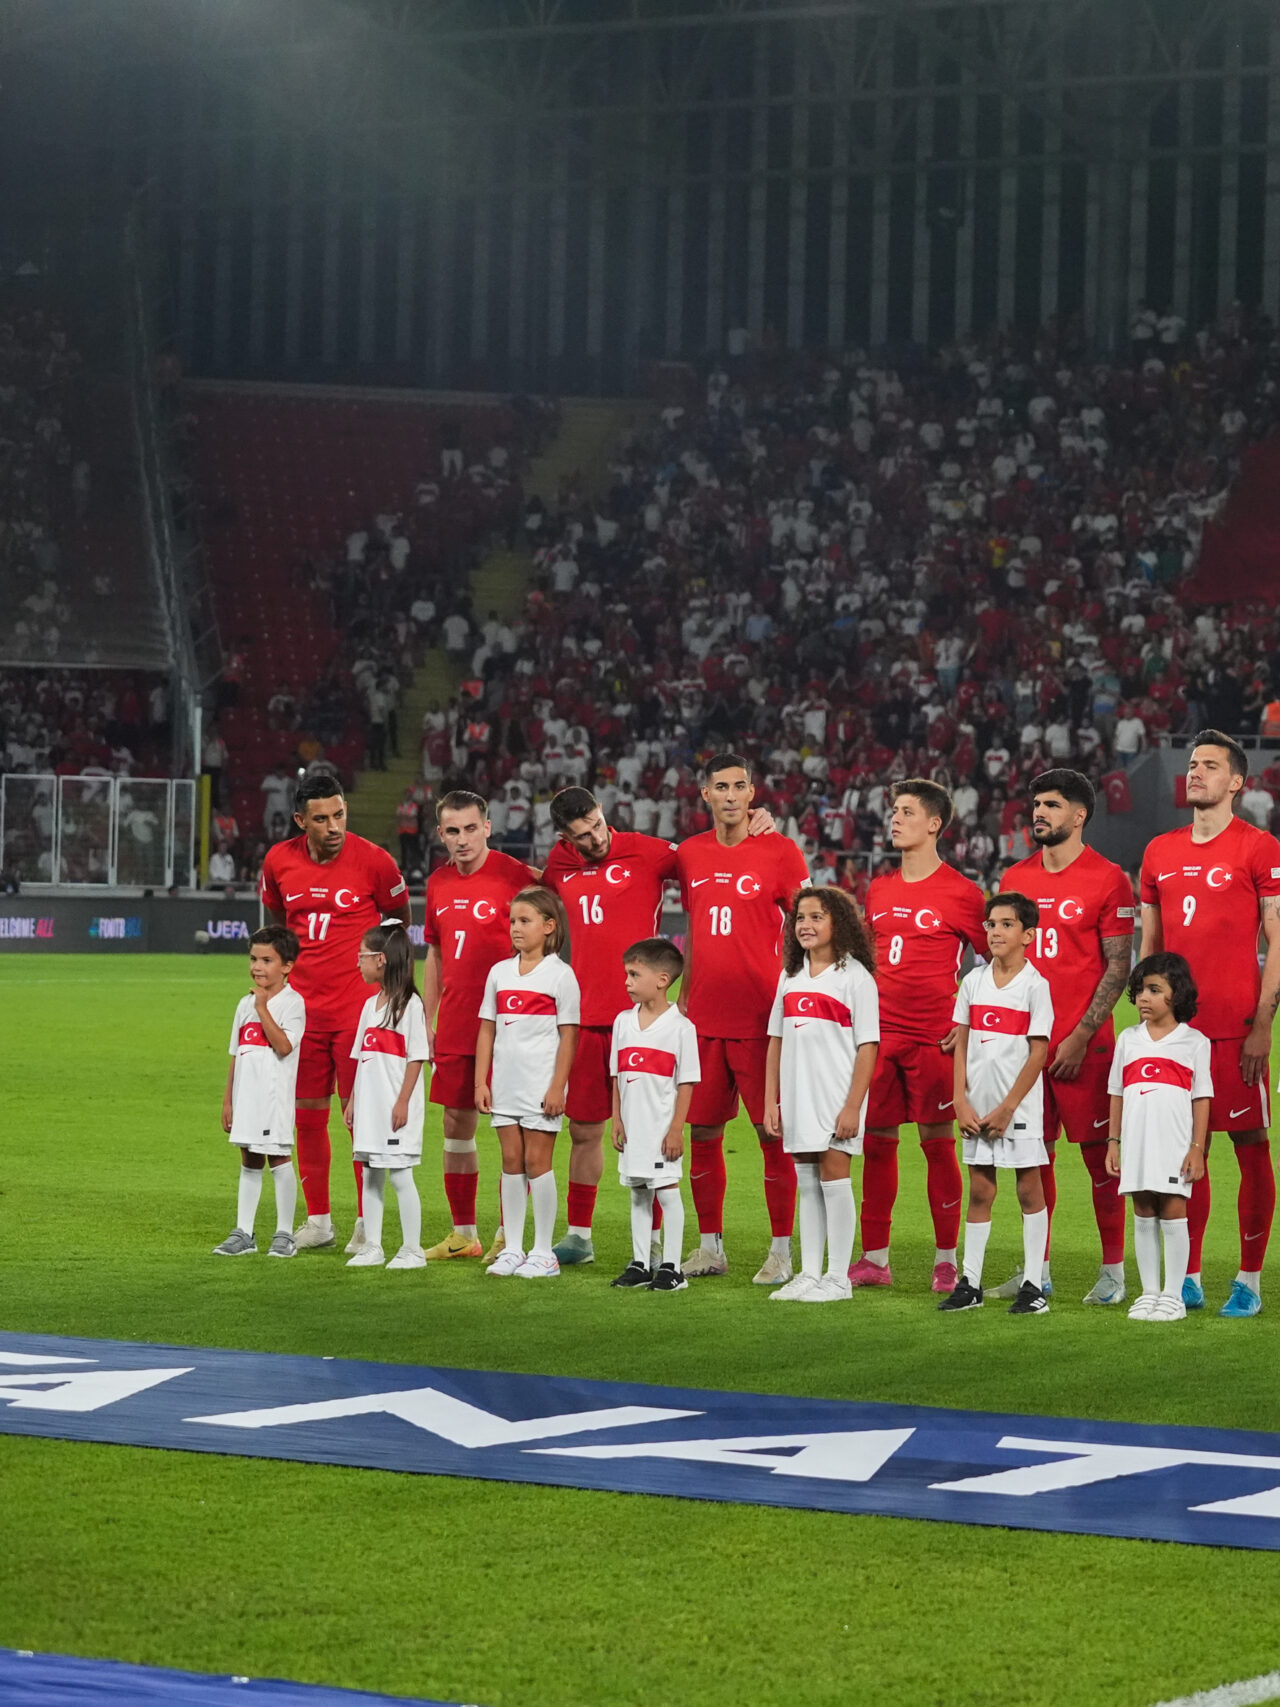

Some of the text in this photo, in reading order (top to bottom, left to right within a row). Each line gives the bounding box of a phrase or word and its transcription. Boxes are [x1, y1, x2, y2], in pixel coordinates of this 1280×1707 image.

[578, 894, 605, 925] 16
[709, 904, 732, 936] 18
[1182, 894, 1198, 928] 9
[0, 917, 35, 939] ELCOME
[208, 920, 249, 939] UEFA
[307, 912, 331, 941] 17
[454, 930, 467, 960] 7
[888, 934, 904, 967] 8
[1035, 927, 1058, 959] 13
